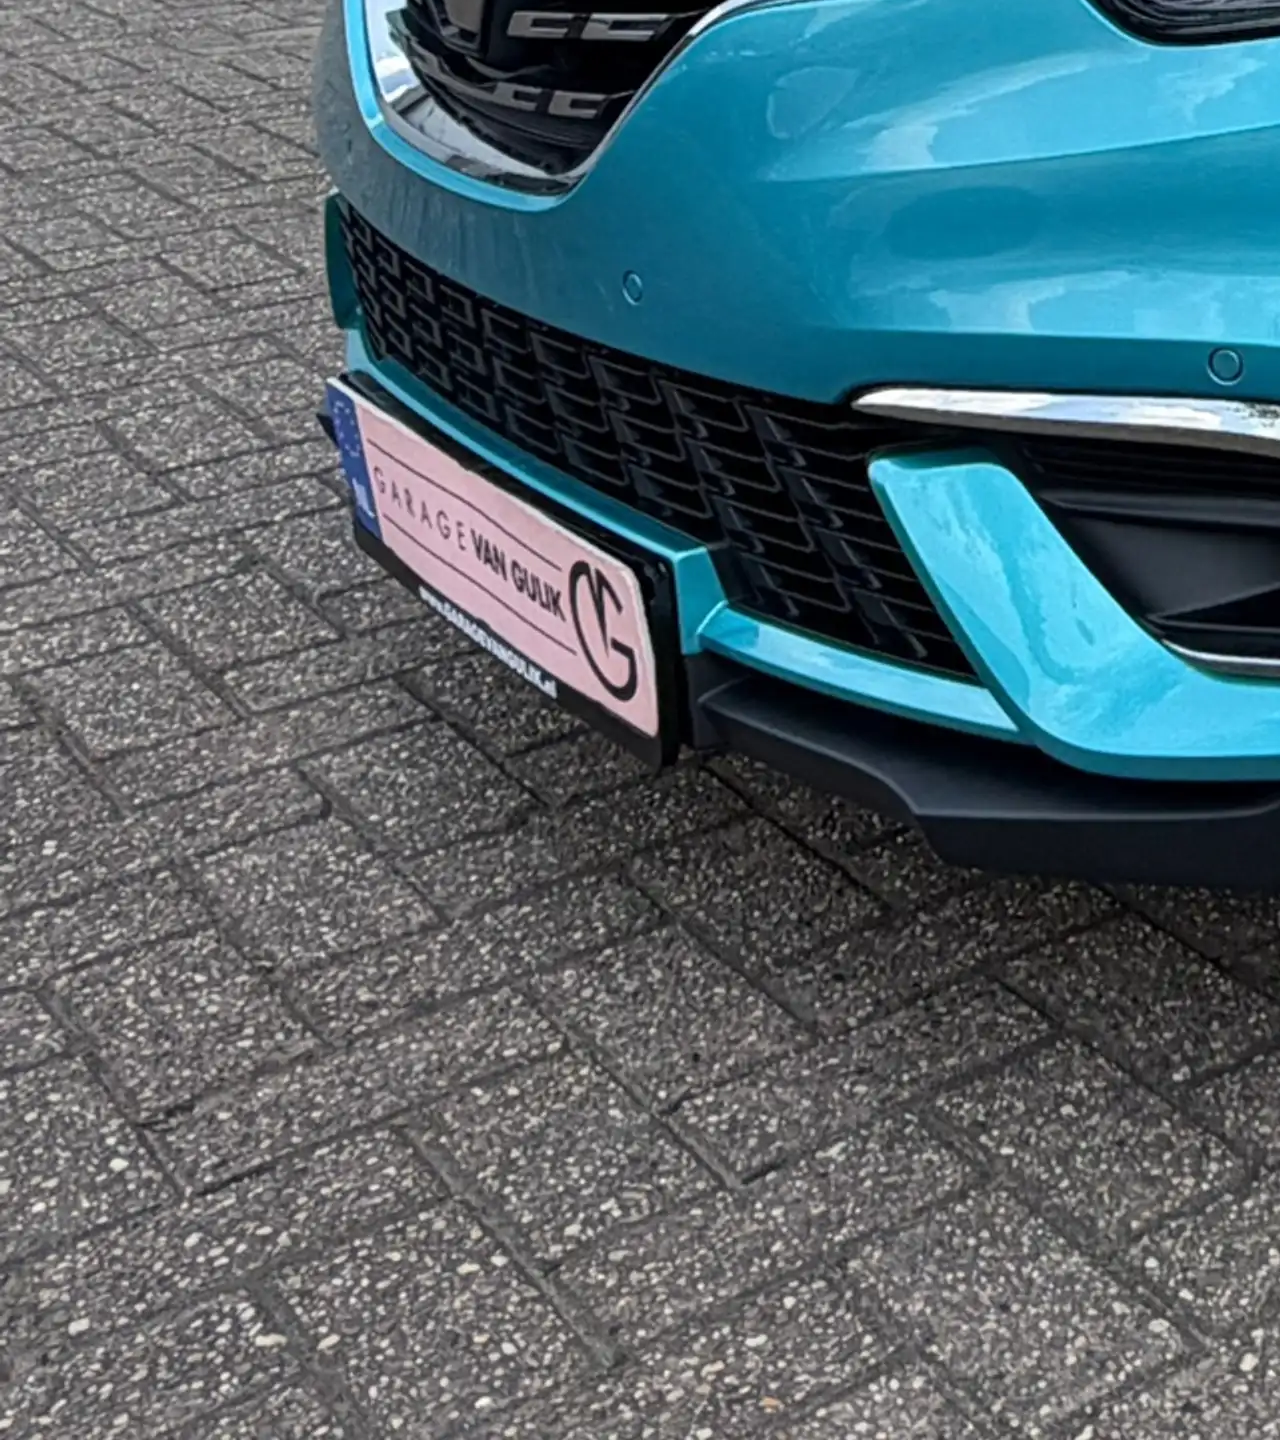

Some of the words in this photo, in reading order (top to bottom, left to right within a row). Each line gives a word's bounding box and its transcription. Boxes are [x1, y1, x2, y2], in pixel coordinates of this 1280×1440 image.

[372, 465, 467, 551] GARAGE
[470, 527, 507, 582] VAN
[511, 559, 567, 623] GULIK
